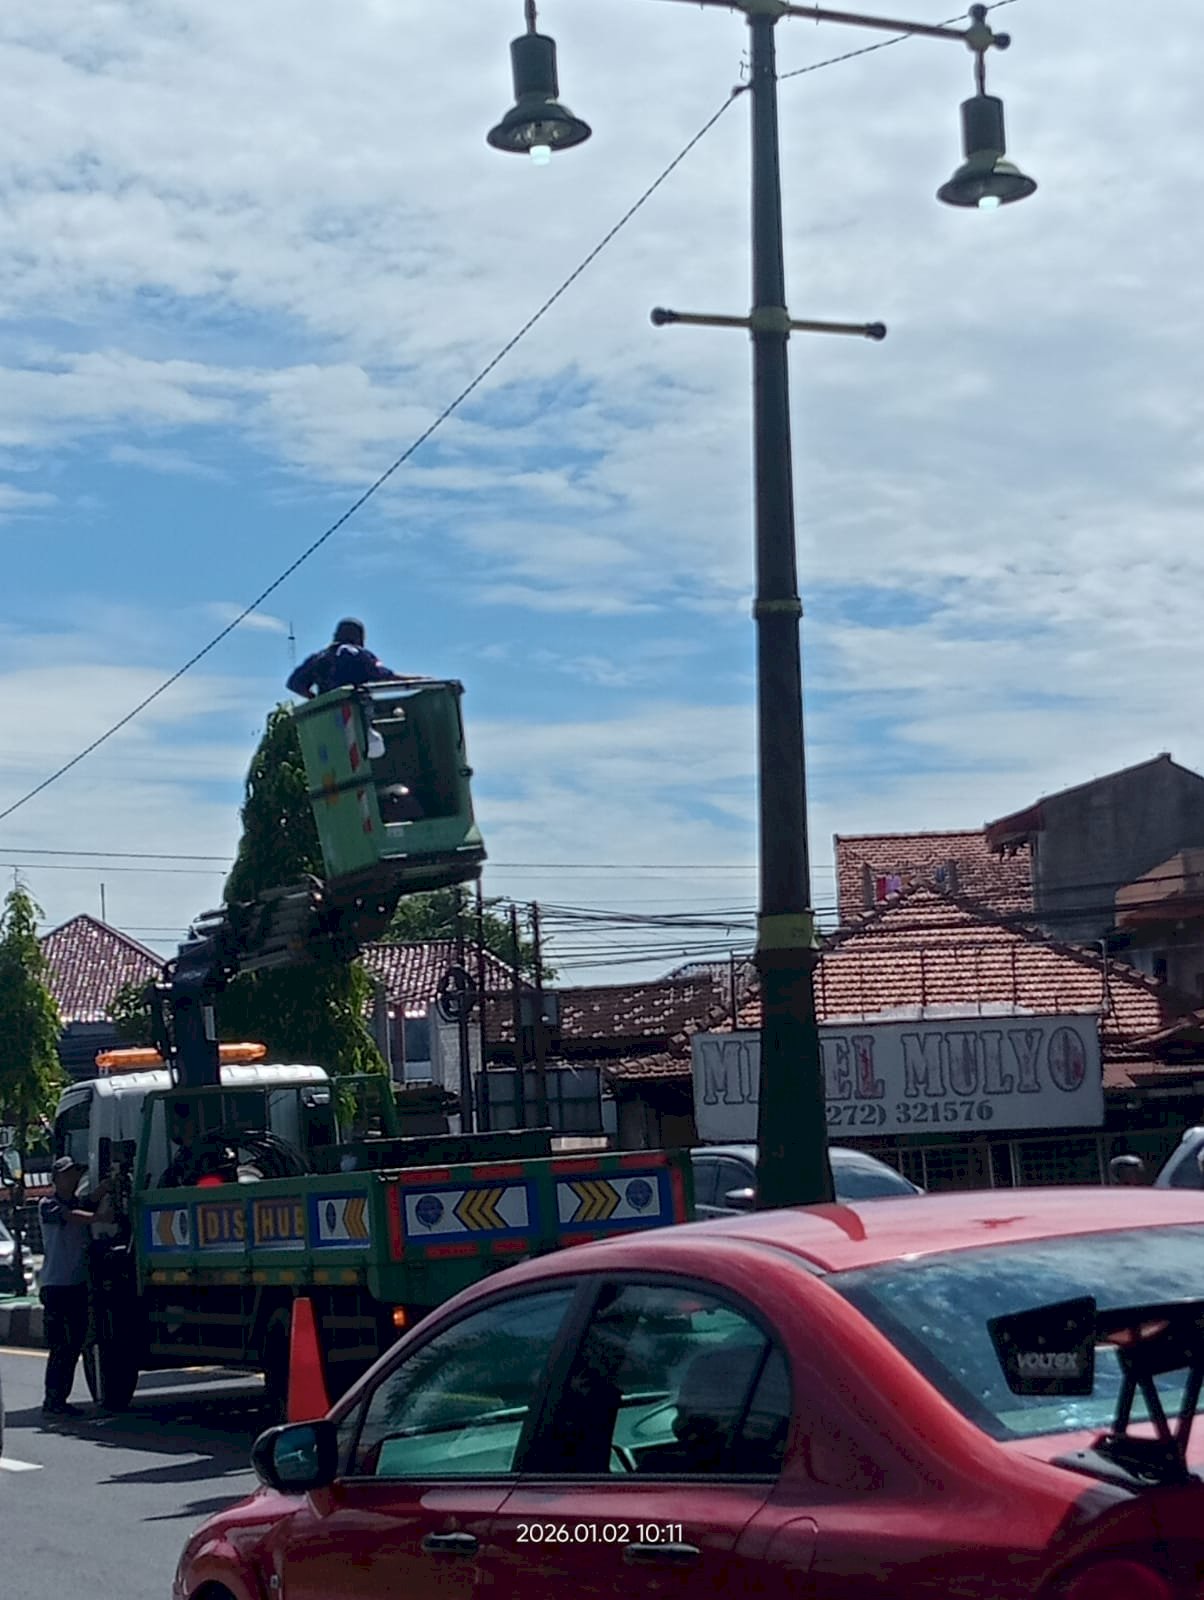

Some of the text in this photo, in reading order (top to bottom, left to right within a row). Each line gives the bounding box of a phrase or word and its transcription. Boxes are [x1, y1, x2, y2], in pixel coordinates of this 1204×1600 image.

[701, 1026, 1086, 1105] MEL MULYO
[896, 1100, 993, 1123] 321576
[206, 1208, 245, 1239] DIS
[1017, 1352, 1078, 1369] VOLTEX
